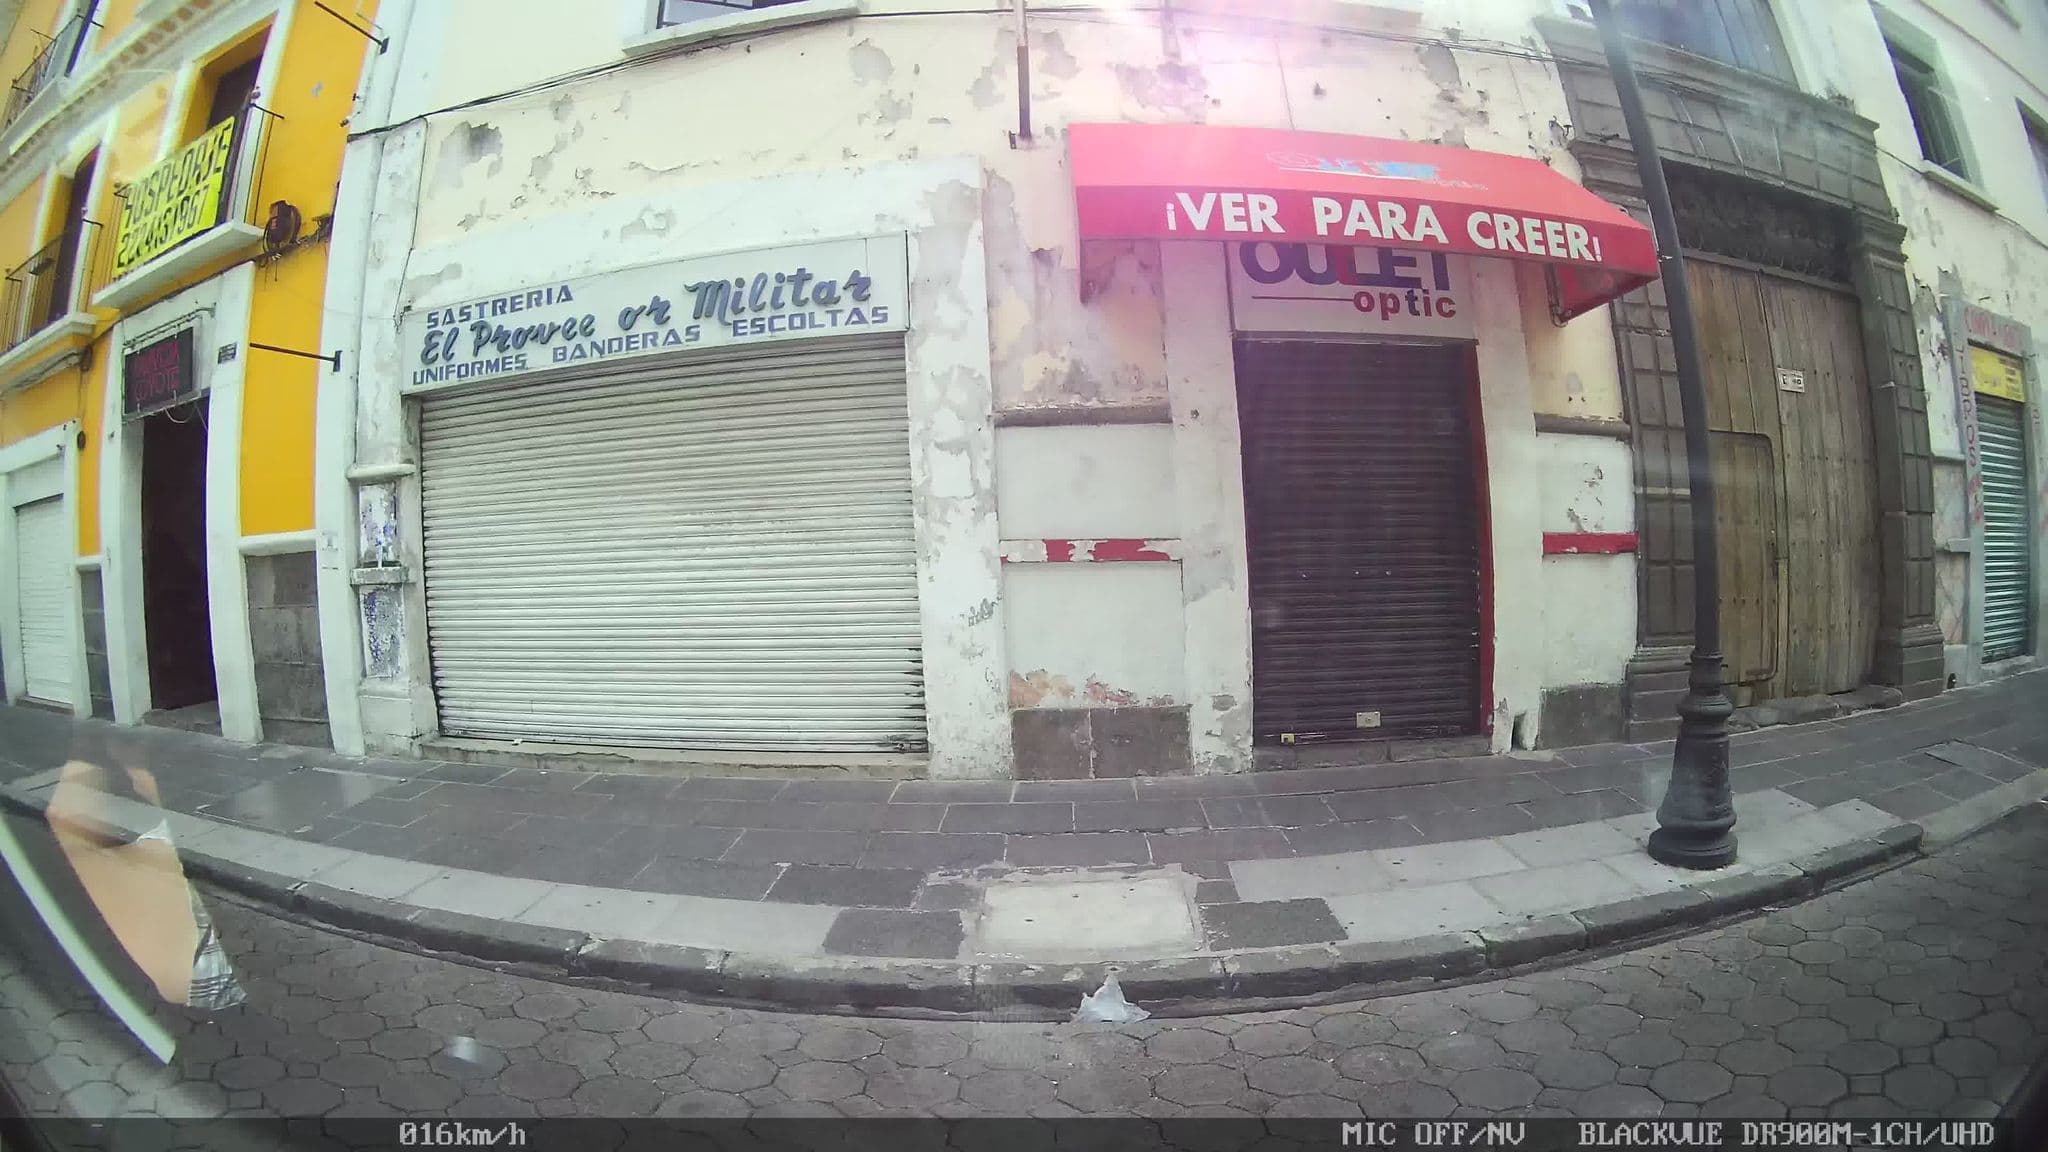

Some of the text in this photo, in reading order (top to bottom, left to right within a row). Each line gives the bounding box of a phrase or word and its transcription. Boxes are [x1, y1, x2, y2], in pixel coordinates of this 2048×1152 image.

[124, 123, 232, 228] HOSPEDAJE
[1312, 197, 1449, 243] PARA
[420, 327, 459, 365] El
[684, 267, 872, 326] Militar
[427, 285, 574, 329] SASTRERIA
[1353, 288, 1456, 320] optic
[413, 306, 888, 386] UNIFORMES BANDERAS ESCOLTAS
